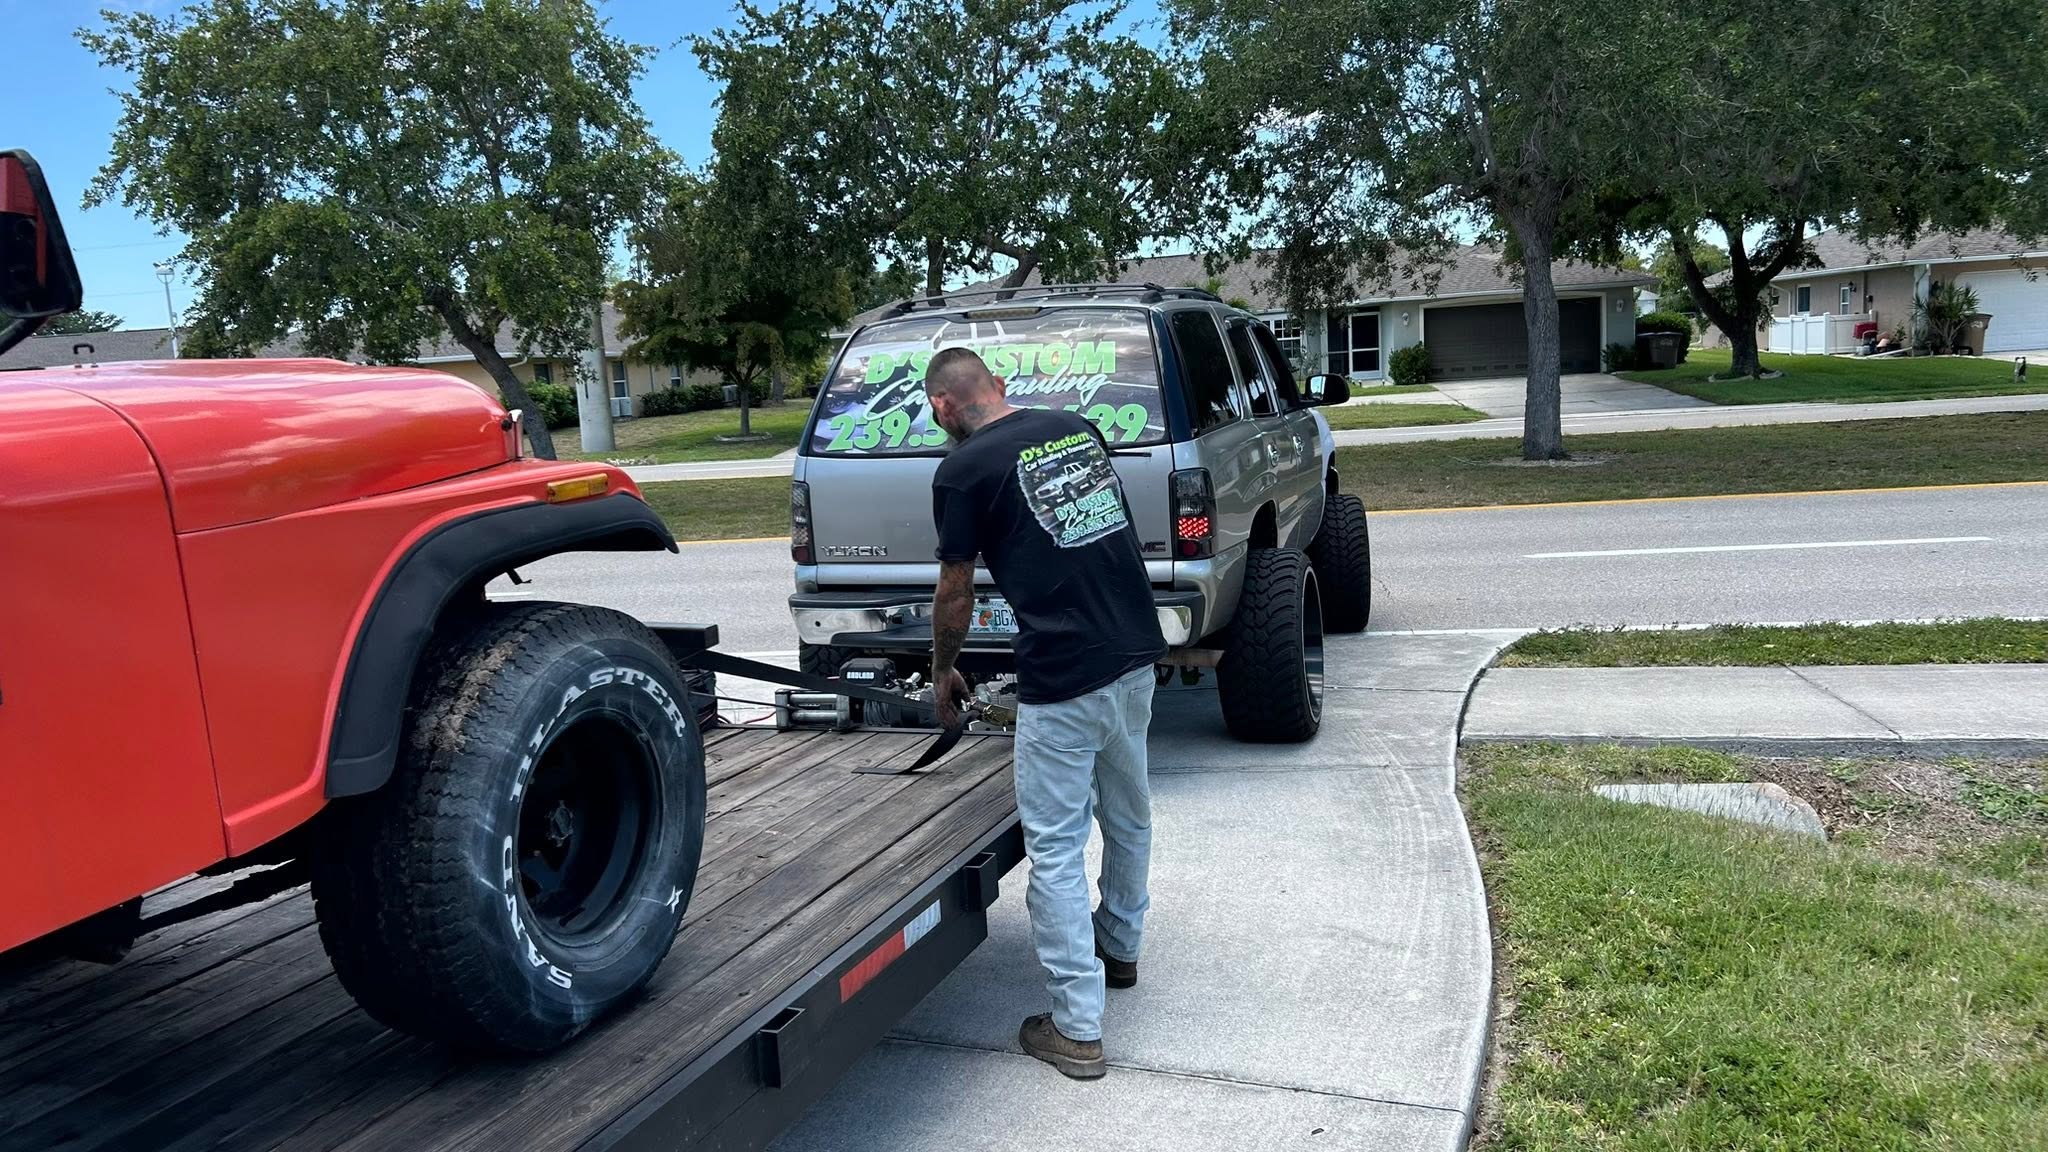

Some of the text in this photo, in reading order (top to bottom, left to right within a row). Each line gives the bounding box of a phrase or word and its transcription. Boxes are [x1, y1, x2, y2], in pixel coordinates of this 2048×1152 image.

[864, 341, 1116, 384] D'S USTOM
[864, 376, 928, 420] Ca
[1020, 432, 1090, 463] D's Custom
[1024, 461, 1038, 472] Car
[1037, 451, 1063, 466] Hauling
[1066, 441, 1095, 454] Transport
[821, 545, 887, 557] YUKON
[1138, 541, 1167, 552] MC
[503, 666, 686, 989] SAND BLASTER
